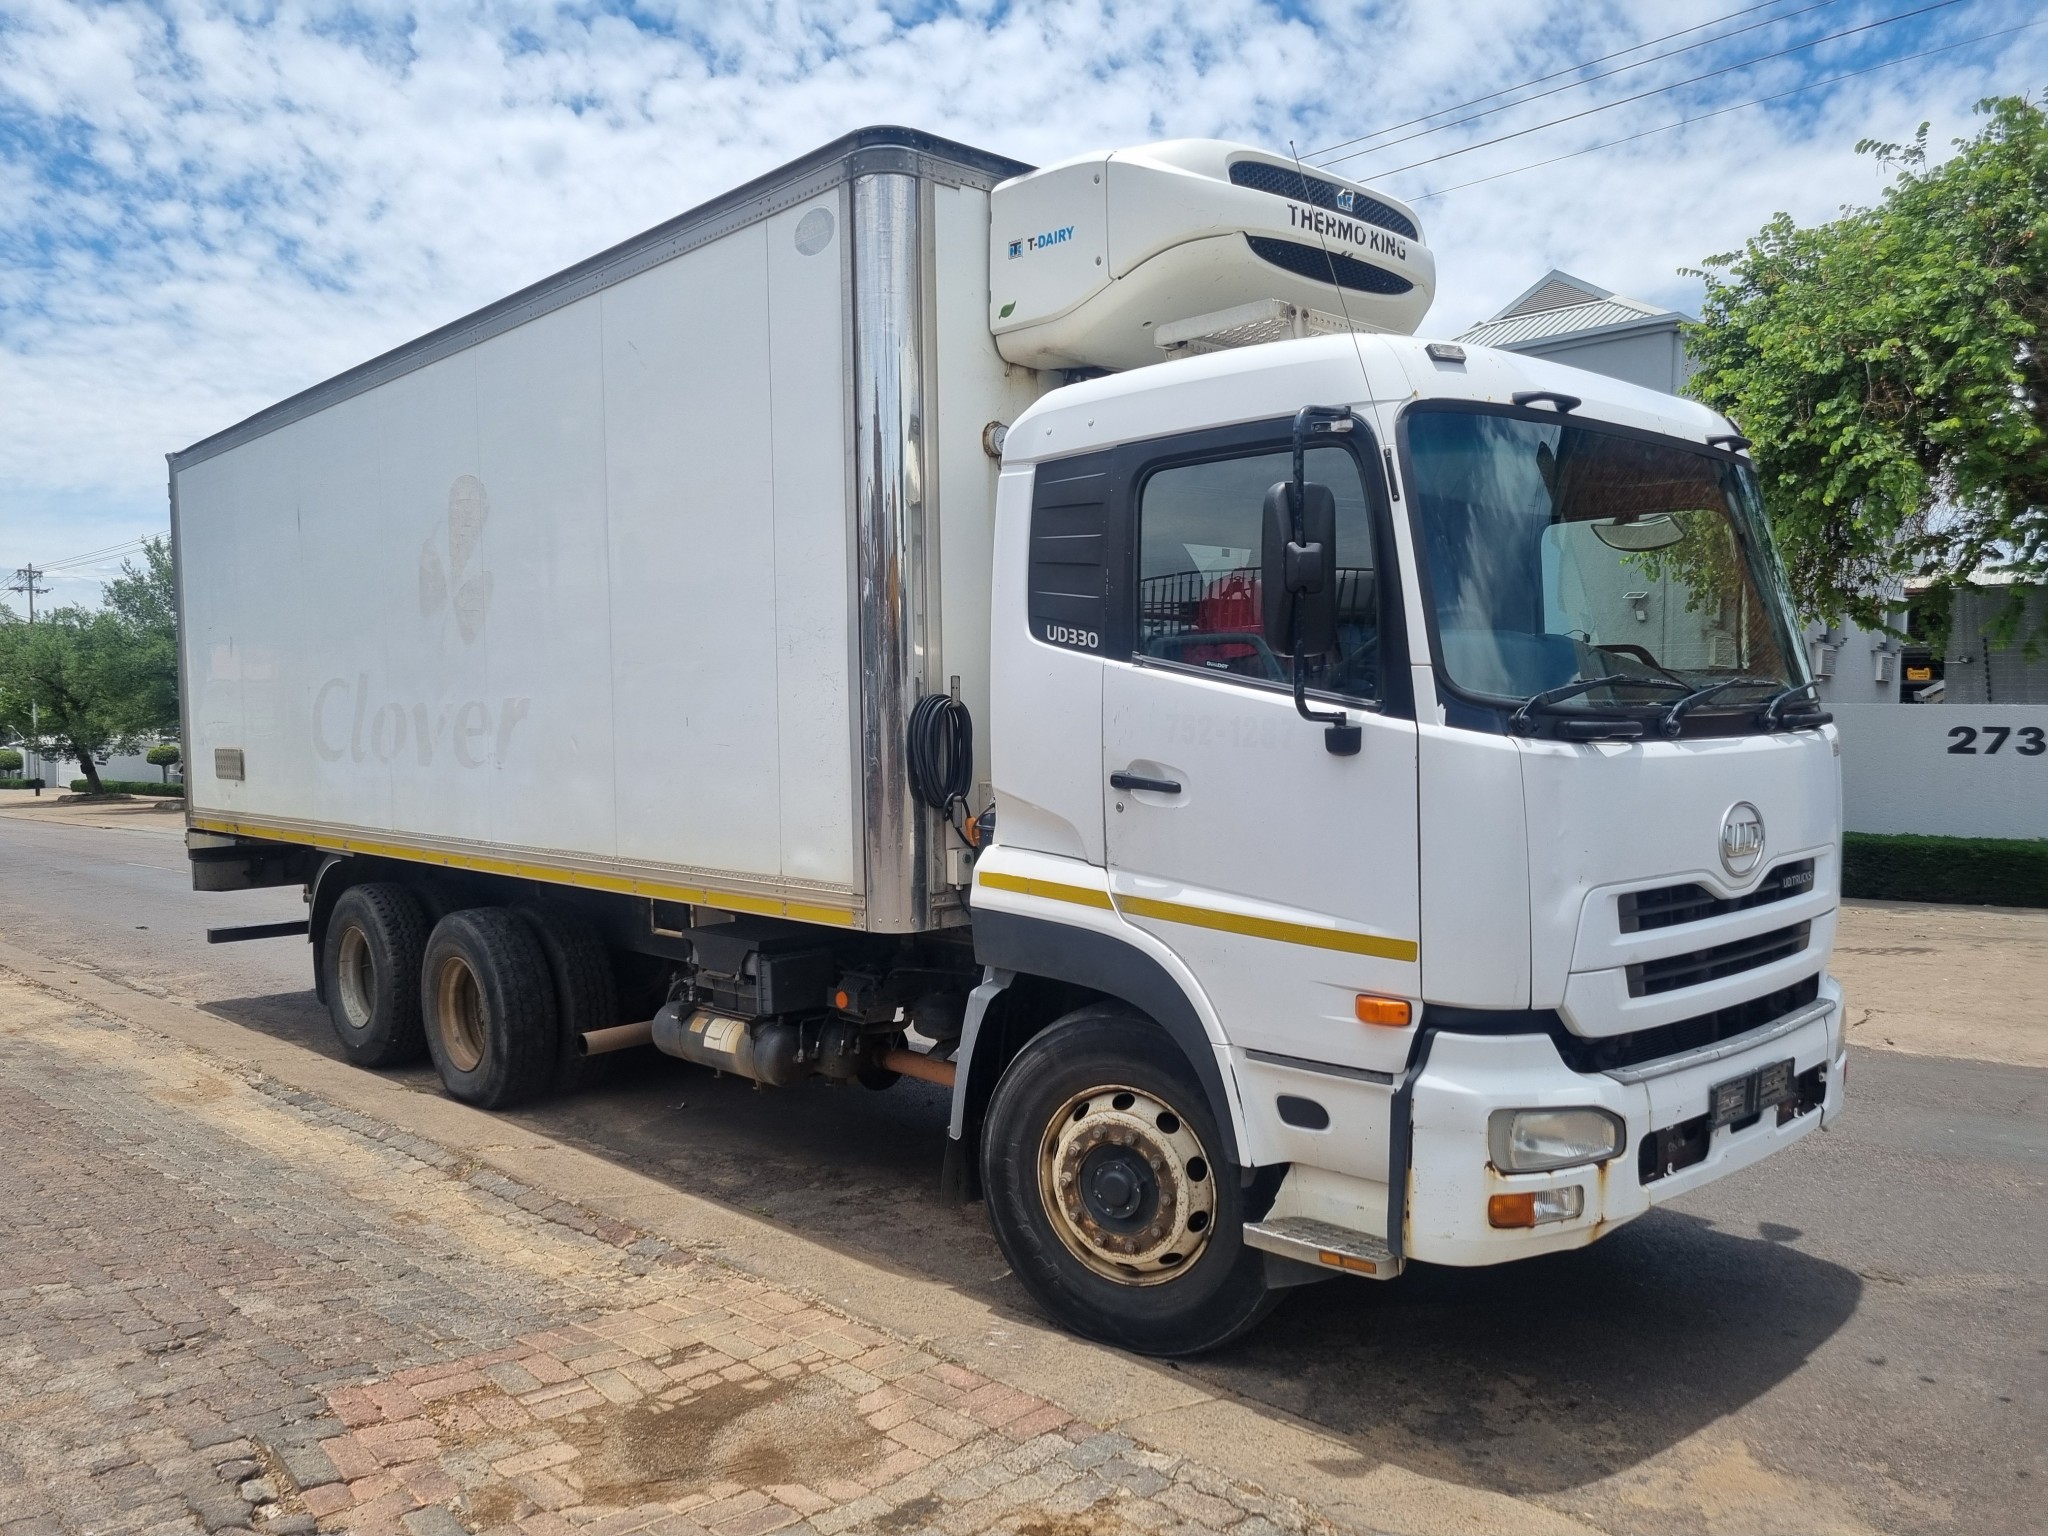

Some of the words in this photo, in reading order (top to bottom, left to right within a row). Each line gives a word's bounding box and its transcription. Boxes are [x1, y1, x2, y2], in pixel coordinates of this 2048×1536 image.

[1027, 226, 1075, 251] T-DAIRY
[1286, 203, 1367, 245] THERMO
[1369, 230, 1406, 261] KING
[1046, 624, 1099, 648] UD330
[311, 672, 531, 770] Clover
[1946, 725, 2047, 756] 273
